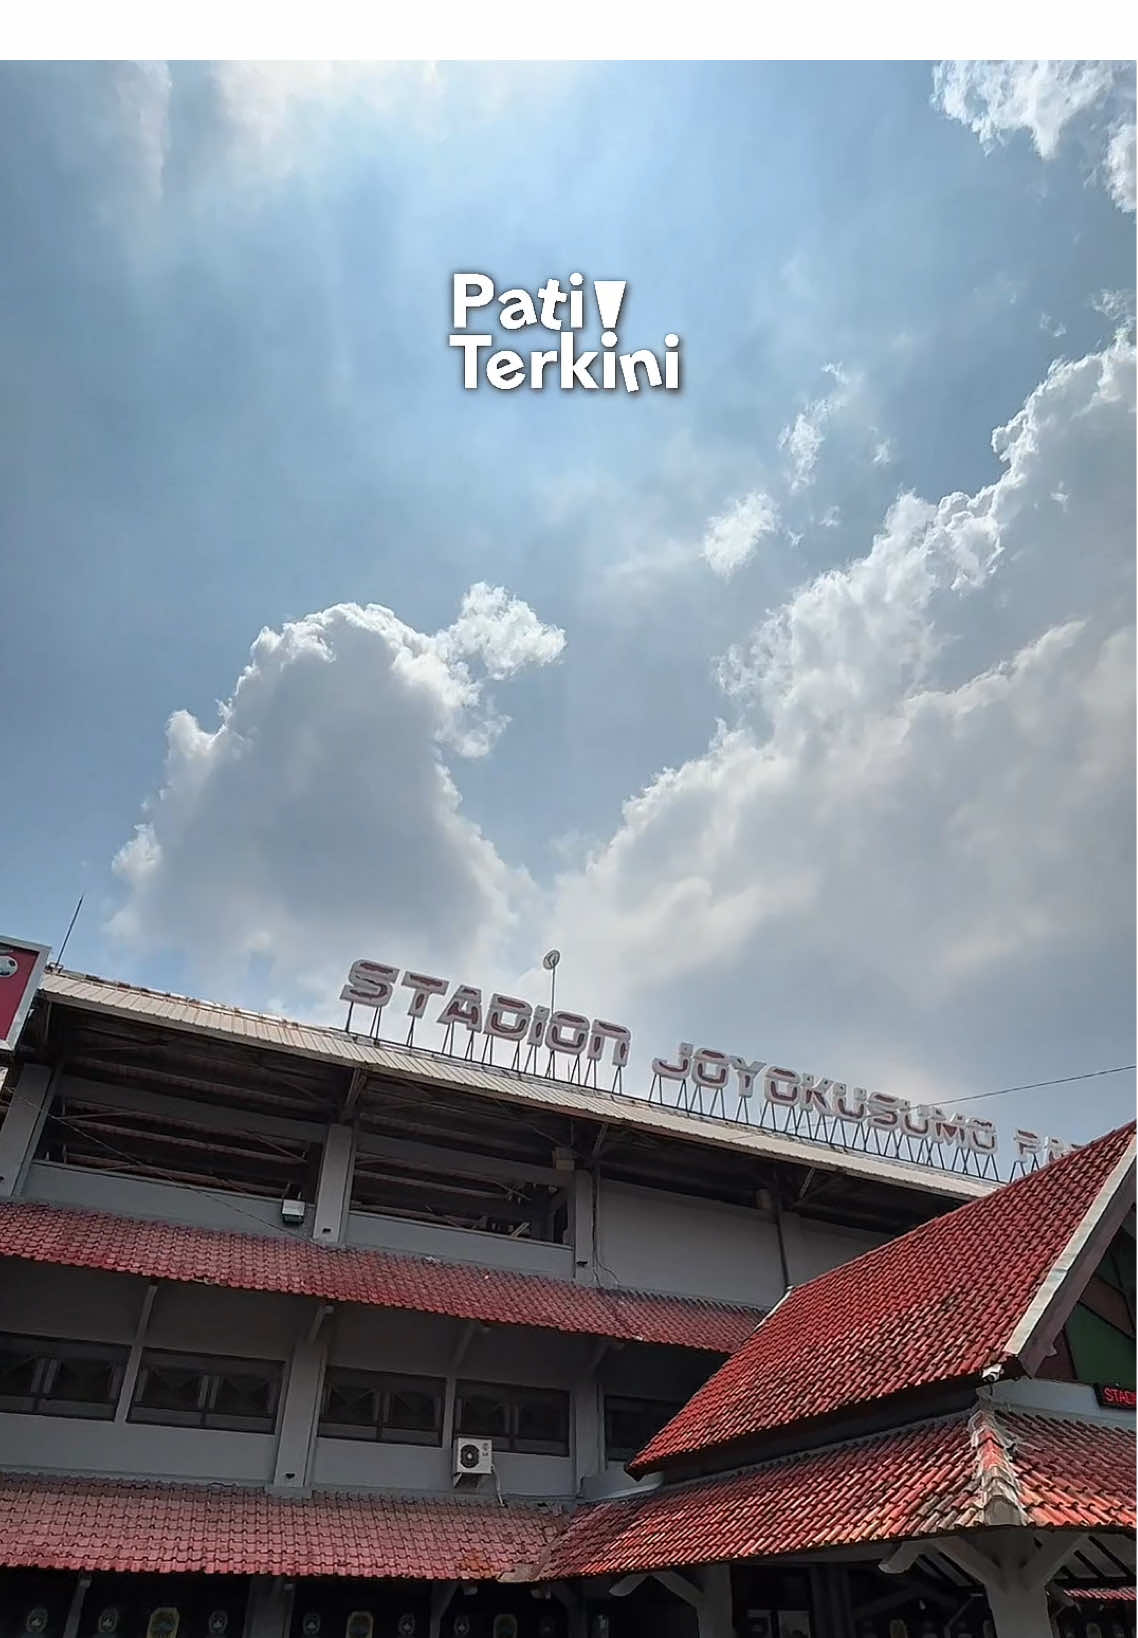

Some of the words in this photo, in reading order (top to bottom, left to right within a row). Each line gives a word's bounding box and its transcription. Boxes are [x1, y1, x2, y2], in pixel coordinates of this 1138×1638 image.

[339, 959, 631, 1067] STADION
[651, 1043, 998, 1155] JOYOKUSUMO
[1013, 1128, 1085, 1163] PA
